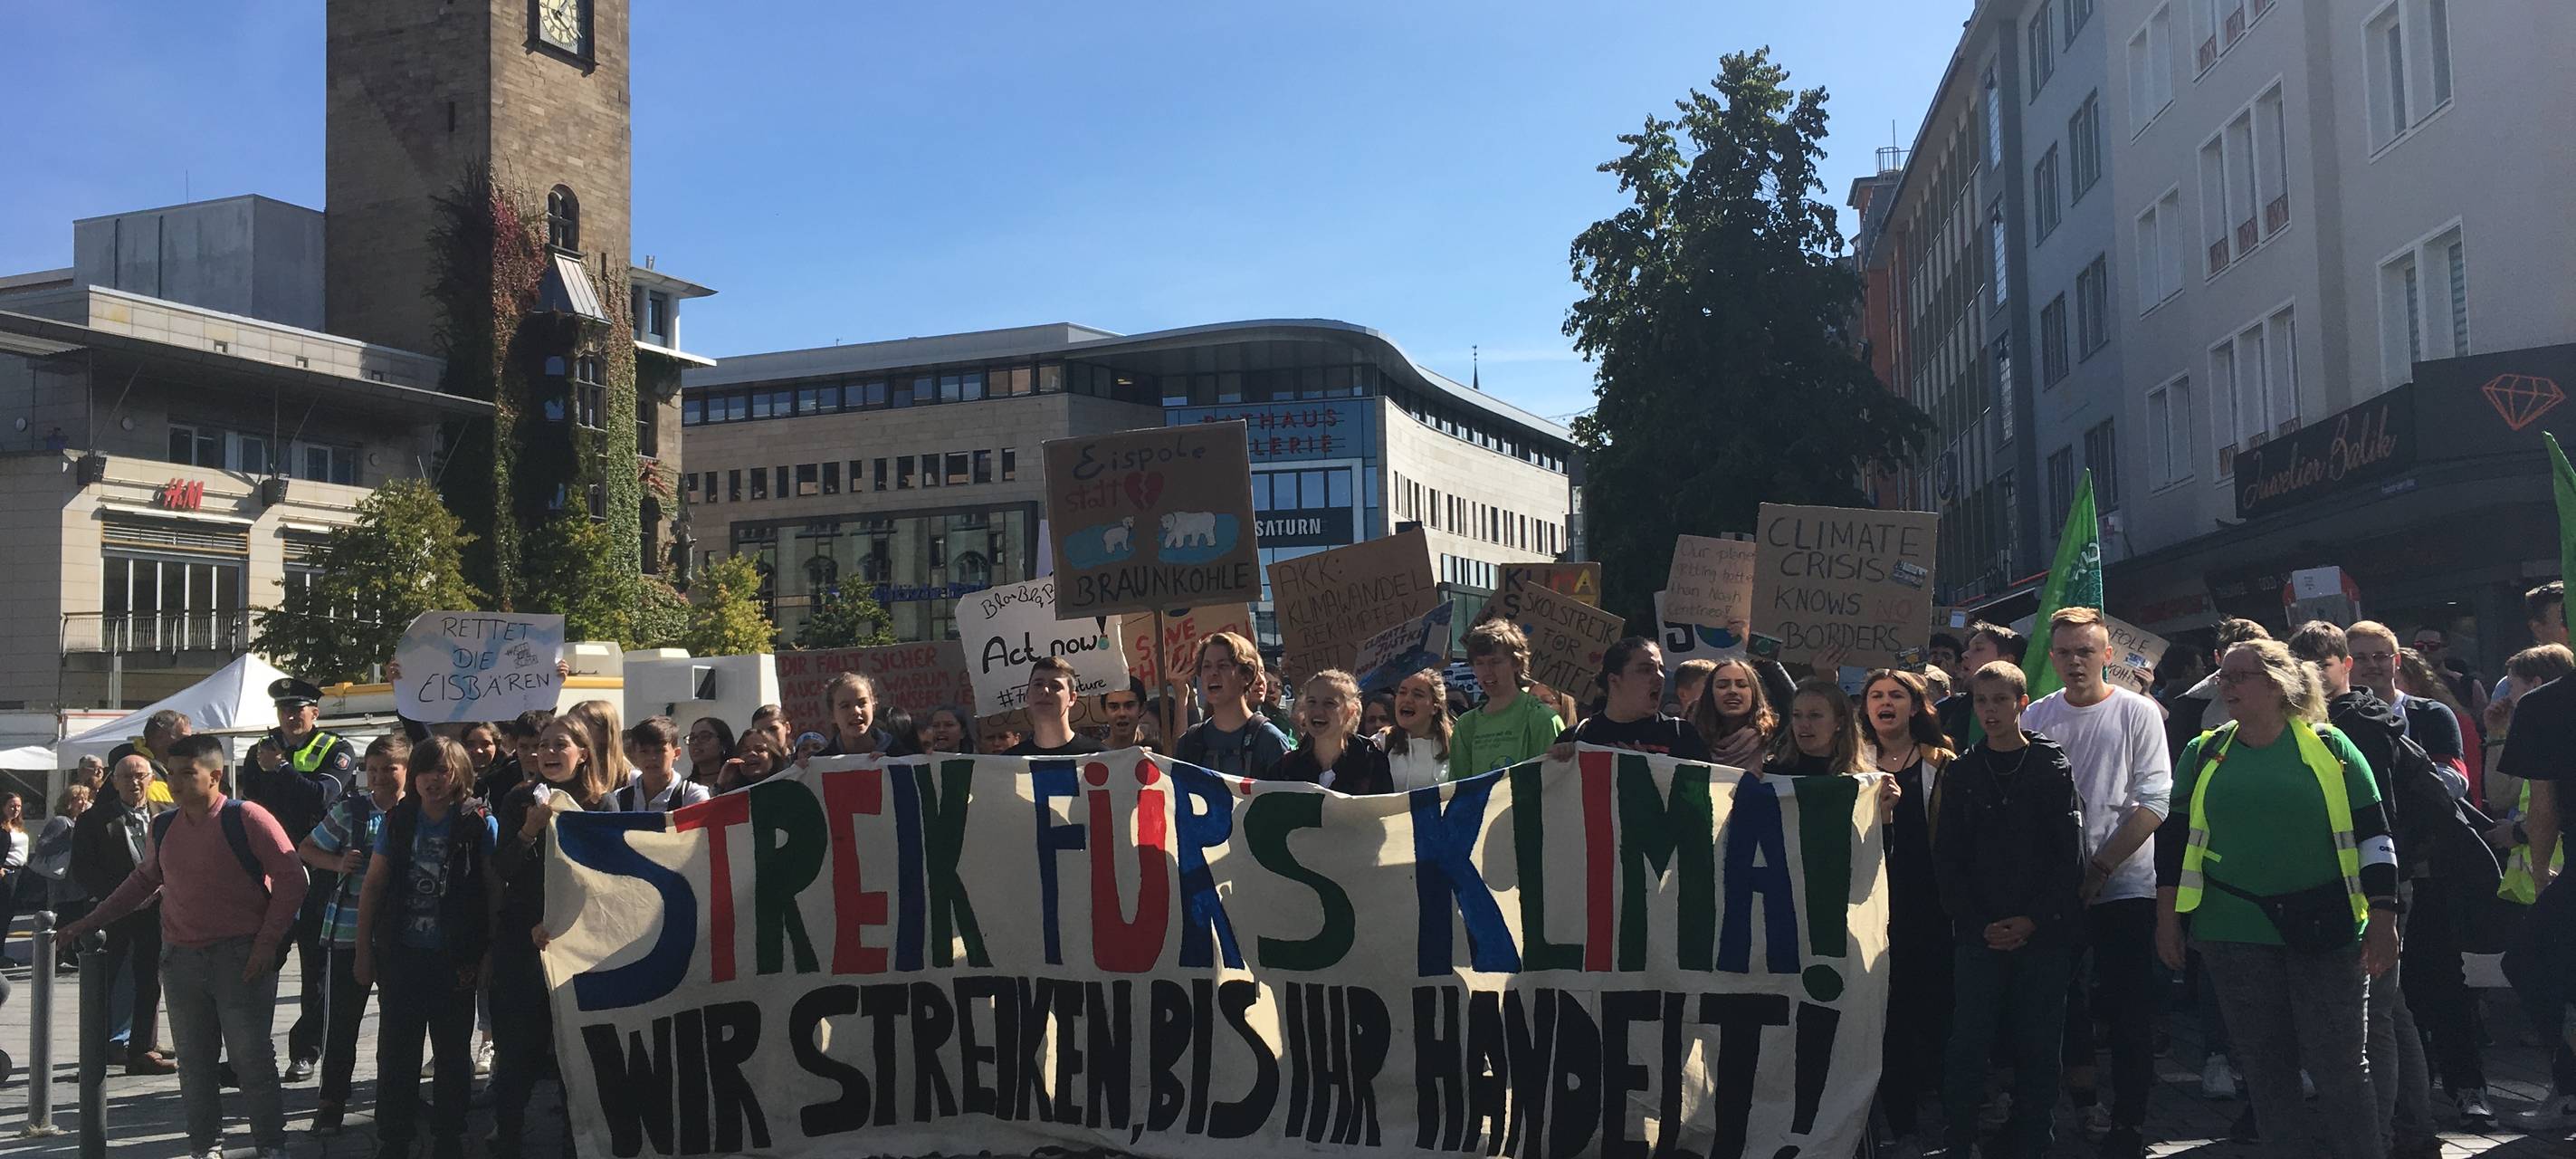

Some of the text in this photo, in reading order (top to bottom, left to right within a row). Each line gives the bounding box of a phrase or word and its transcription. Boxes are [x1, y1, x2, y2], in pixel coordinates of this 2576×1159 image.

[1203, 411, 1336, 430] THAUS
[1073, 436, 1207, 480] Eispole
[1253, 435, 1334, 455] LERIE
[164, 477, 204, 512] H&M
[1065, 479, 1123, 512] statt
[1255, 518, 1321, 537] SATURN
[1768, 516, 1925, 557] CLIMATE
[1278, 556, 1343, 598] AKK:
[1779, 551, 1885, 582] CRISIS
[1073, 562, 1250, 608] BRAUNKOHLE
[1285, 570, 1431, 630] KLIMAWANDEL
[1522, 592, 1618, 646] SKOLSTREJK
[1774, 585, 1863, 616] KNOWS
[1875, 599, 1913, 622] NO
[441, 617, 536, 641] RETTET
[1136, 618, 1196, 661] SVE
[1364, 622, 1410, 651] CLIMATE
[1543, 627, 1581, 659] FÖR
[1778, 621, 1901, 652] BORDERS
[453, 647, 493, 670] DIE
[869, 647, 937, 675] SICHER
[983, 632, 1042, 675] Act
[418, 673, 550, 703] EISBÄREN
[556, 758, 994, 1011] STREIK
[1409, 750, 1859, 1002] KLIMA!
[580, 1001, 773, 1158] WIR
[1149, 976, 1280, 1139] BIS
[1284, 981, 1392, 1147] IHR
[1411, 987, 1841, 1159] HANDELT!
